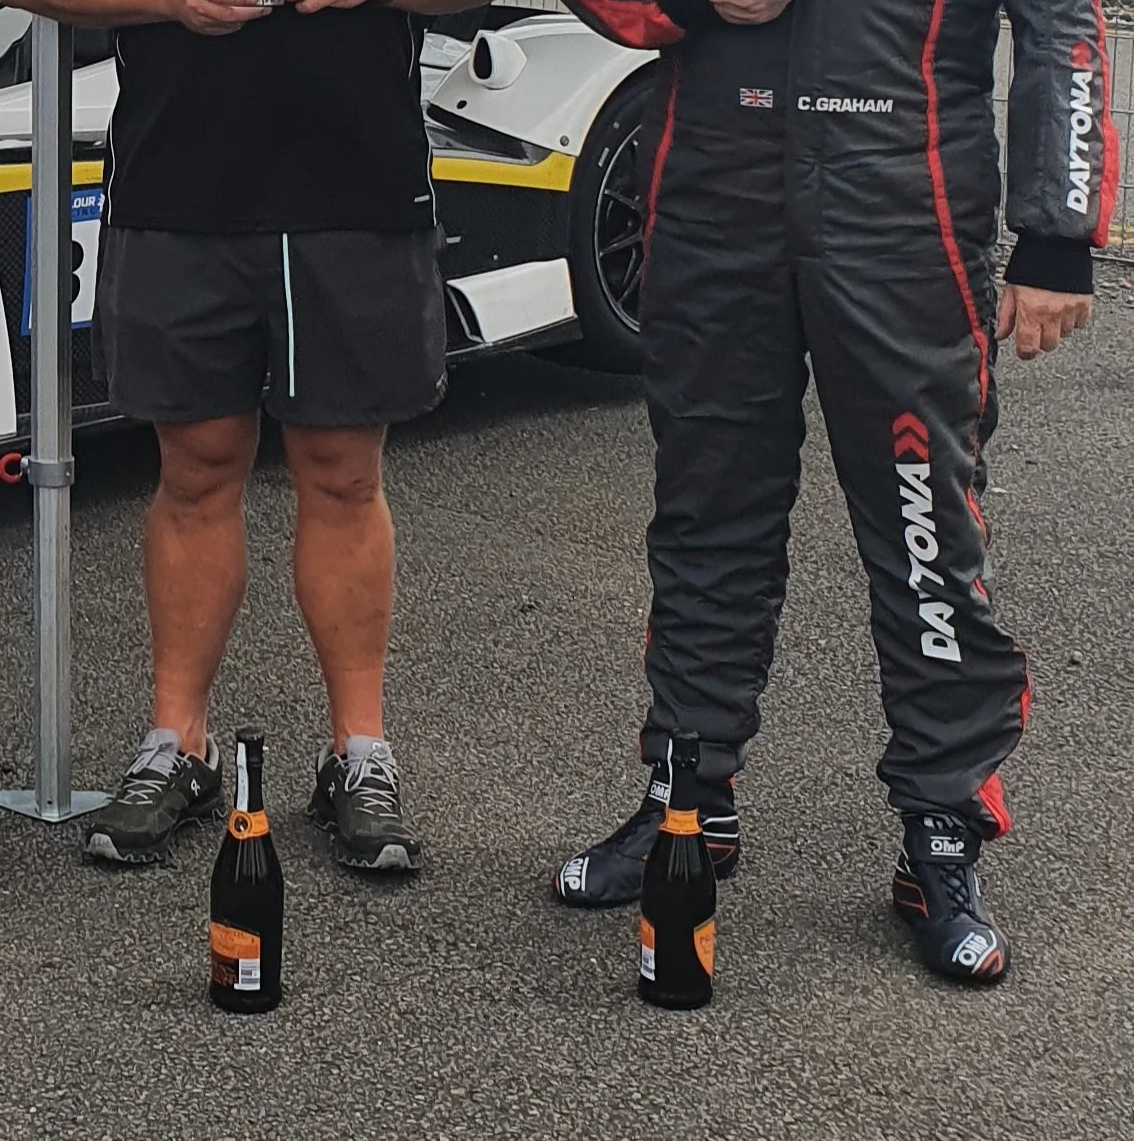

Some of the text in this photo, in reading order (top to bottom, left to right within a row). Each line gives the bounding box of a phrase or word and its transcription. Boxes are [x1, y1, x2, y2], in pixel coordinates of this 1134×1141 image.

[797, 96, 893, 113] C.GRAHAM
[1066, 71, 1094, 215] DAYTONA
[72, 195, 96, 209] OUR
[895, 463, 962, 663] DAYTONA
[930, 839, 965, 853] OMP
[564, 857, 585, 891] OMP
[958, 934, 990, 966] OMP
